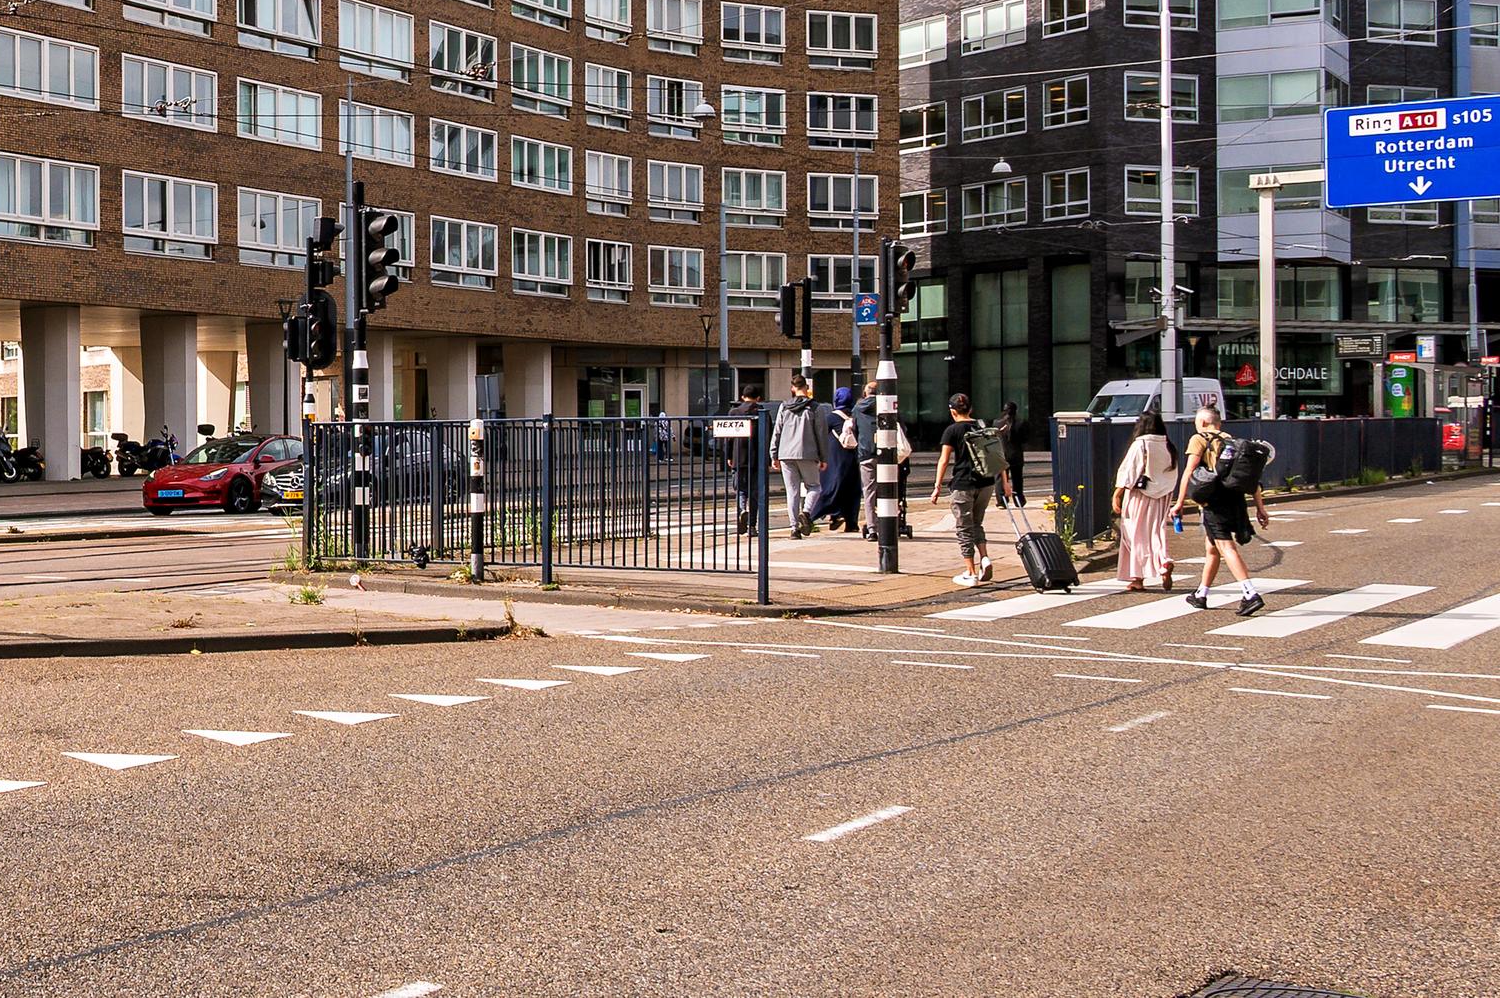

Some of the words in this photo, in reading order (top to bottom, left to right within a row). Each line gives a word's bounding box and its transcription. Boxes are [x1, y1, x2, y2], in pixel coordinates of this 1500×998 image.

[1355, 117, 1392, 132] Ring
[1402, 114, 1435, 128] A10
[1452, 108, 1493, 125] s105
[1375, 136, 1474, 155] Rotterdam
[1384, 156, 1456, 173] Utrecht
